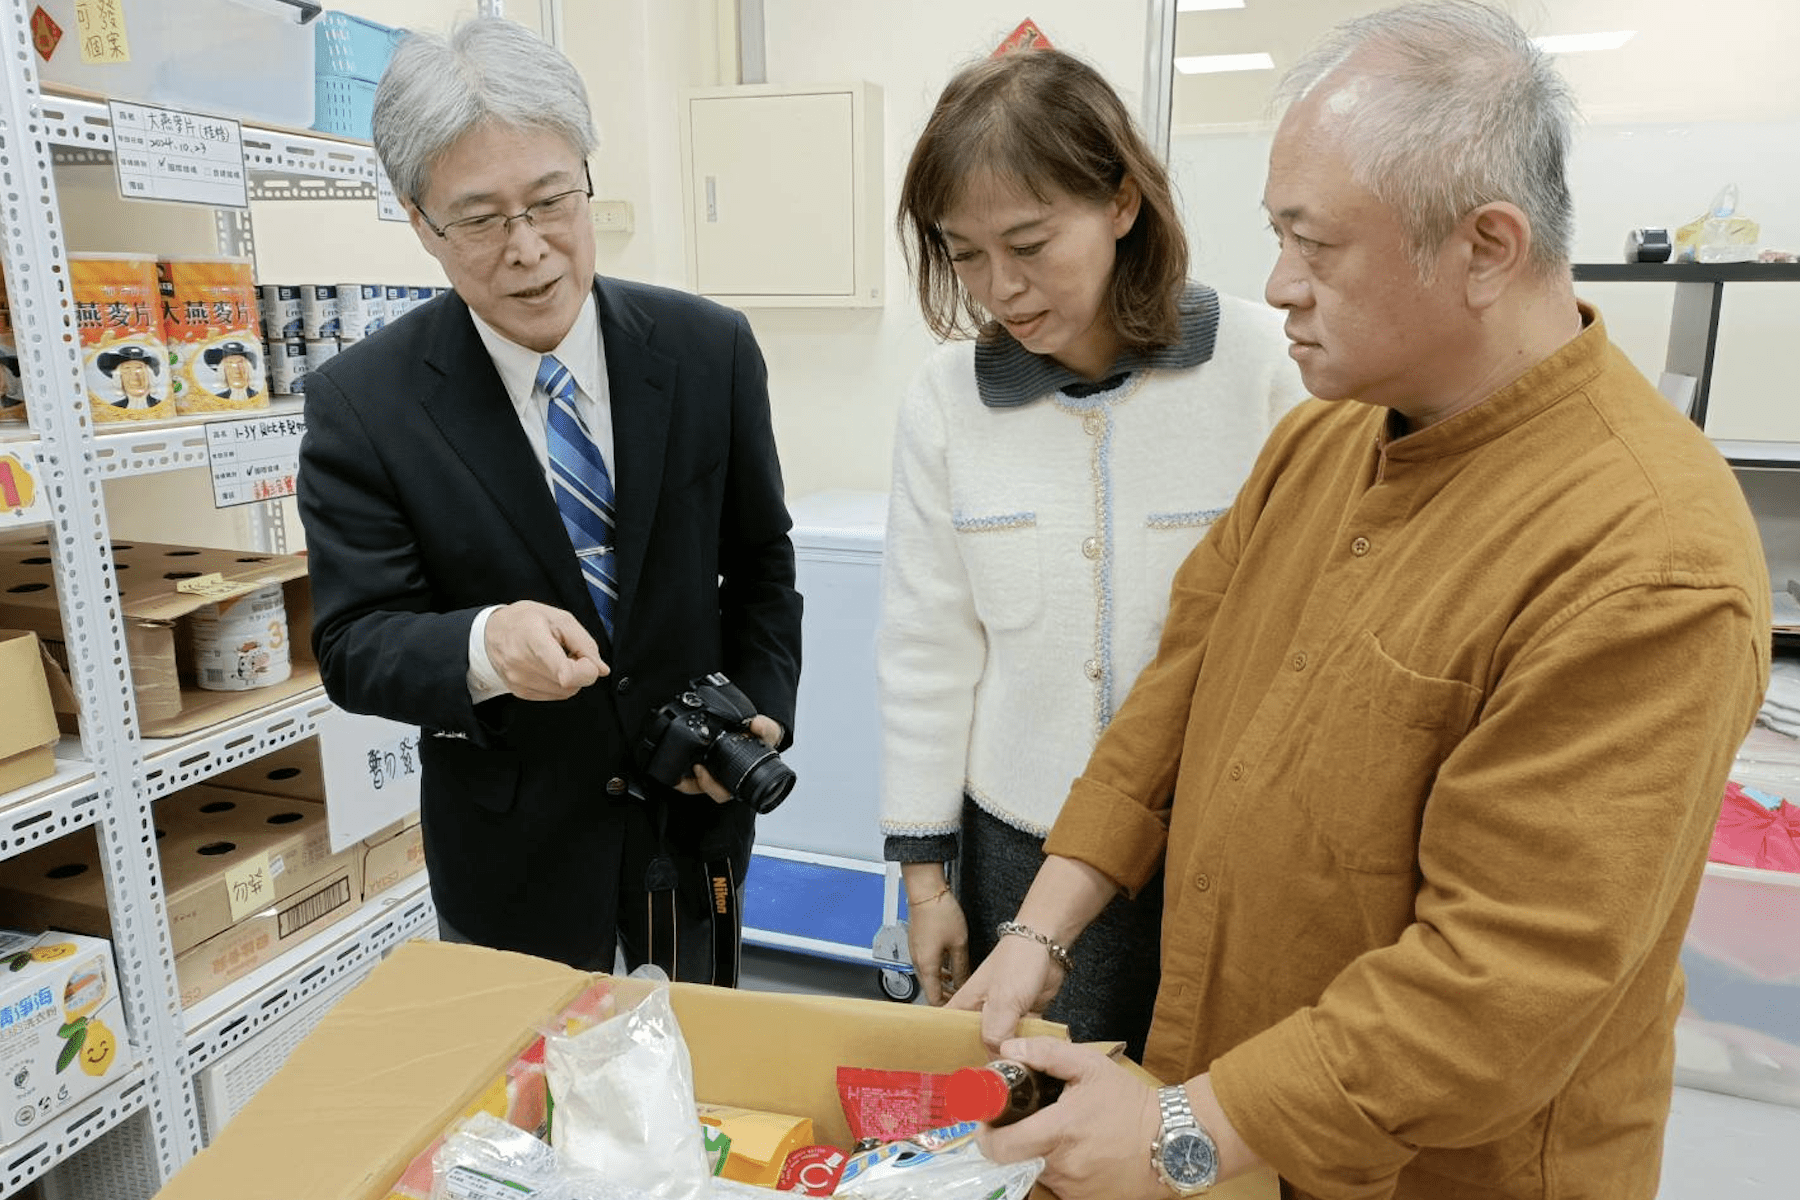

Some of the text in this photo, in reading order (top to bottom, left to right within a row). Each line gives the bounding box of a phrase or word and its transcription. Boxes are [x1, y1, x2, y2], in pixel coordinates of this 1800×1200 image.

[161, 301, 250, 326] 大燕麥片
[268, 620, 284, 649] 3
[712, 876, 728, 914] Nikon
